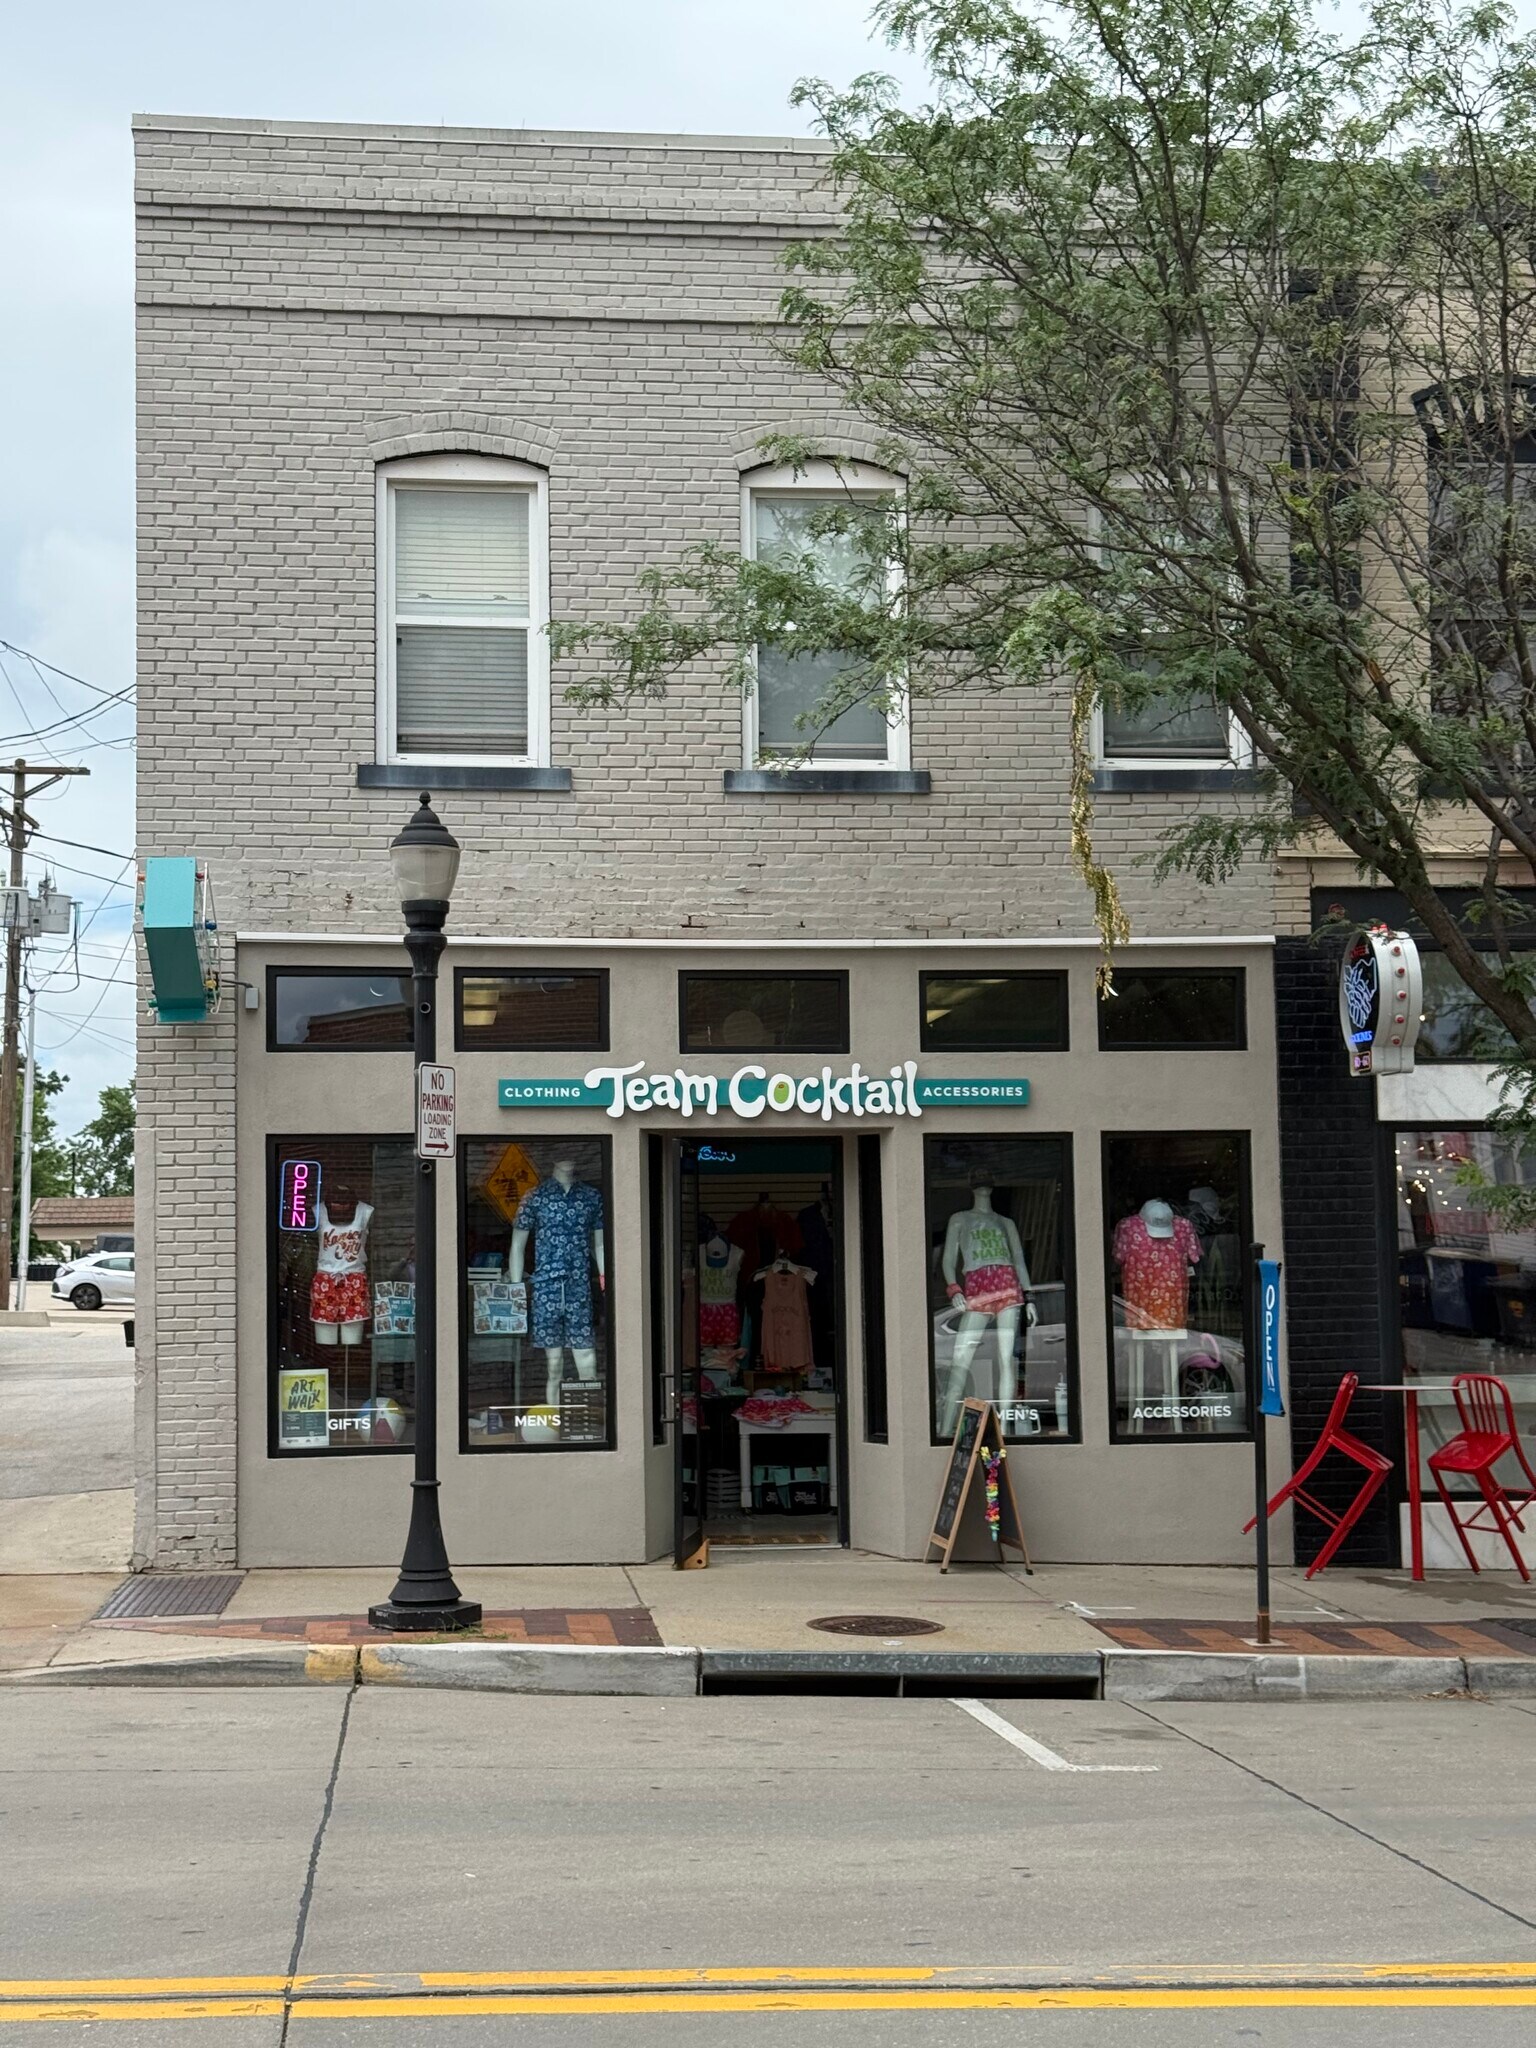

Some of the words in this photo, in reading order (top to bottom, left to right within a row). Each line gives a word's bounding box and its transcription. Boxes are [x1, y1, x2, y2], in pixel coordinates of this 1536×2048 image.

[431, 1072, 445, 1090] NO
[504, 1087, 581, 1098] CLOTHING
[584, 1060, 718, 1118] Team
[728, 1060, 923, 1122] Cocktail
[922, 1085, 1024, 1098] ACCESSORIES
[422, 1093, 454, 1112] PARKING
[423, 1112, 452, 1126] LOADING
[428, 1127, 447, 1140] ZONE
[291, 1163, 309, 1228] OPEN
[1265, 1284, 1276, 1390] OPEN
[290, 1379, 316, 1396] ART
[287, 1389, 321, 1411] WALK
[996, 1408, 1039, 1421] MEN'S
[1133, 1405, 1233, 1419] ACCESSORIES
[327, 1418, 371, 1431] GIFTS
[514, 1414, 562, 1427] MEN'S
